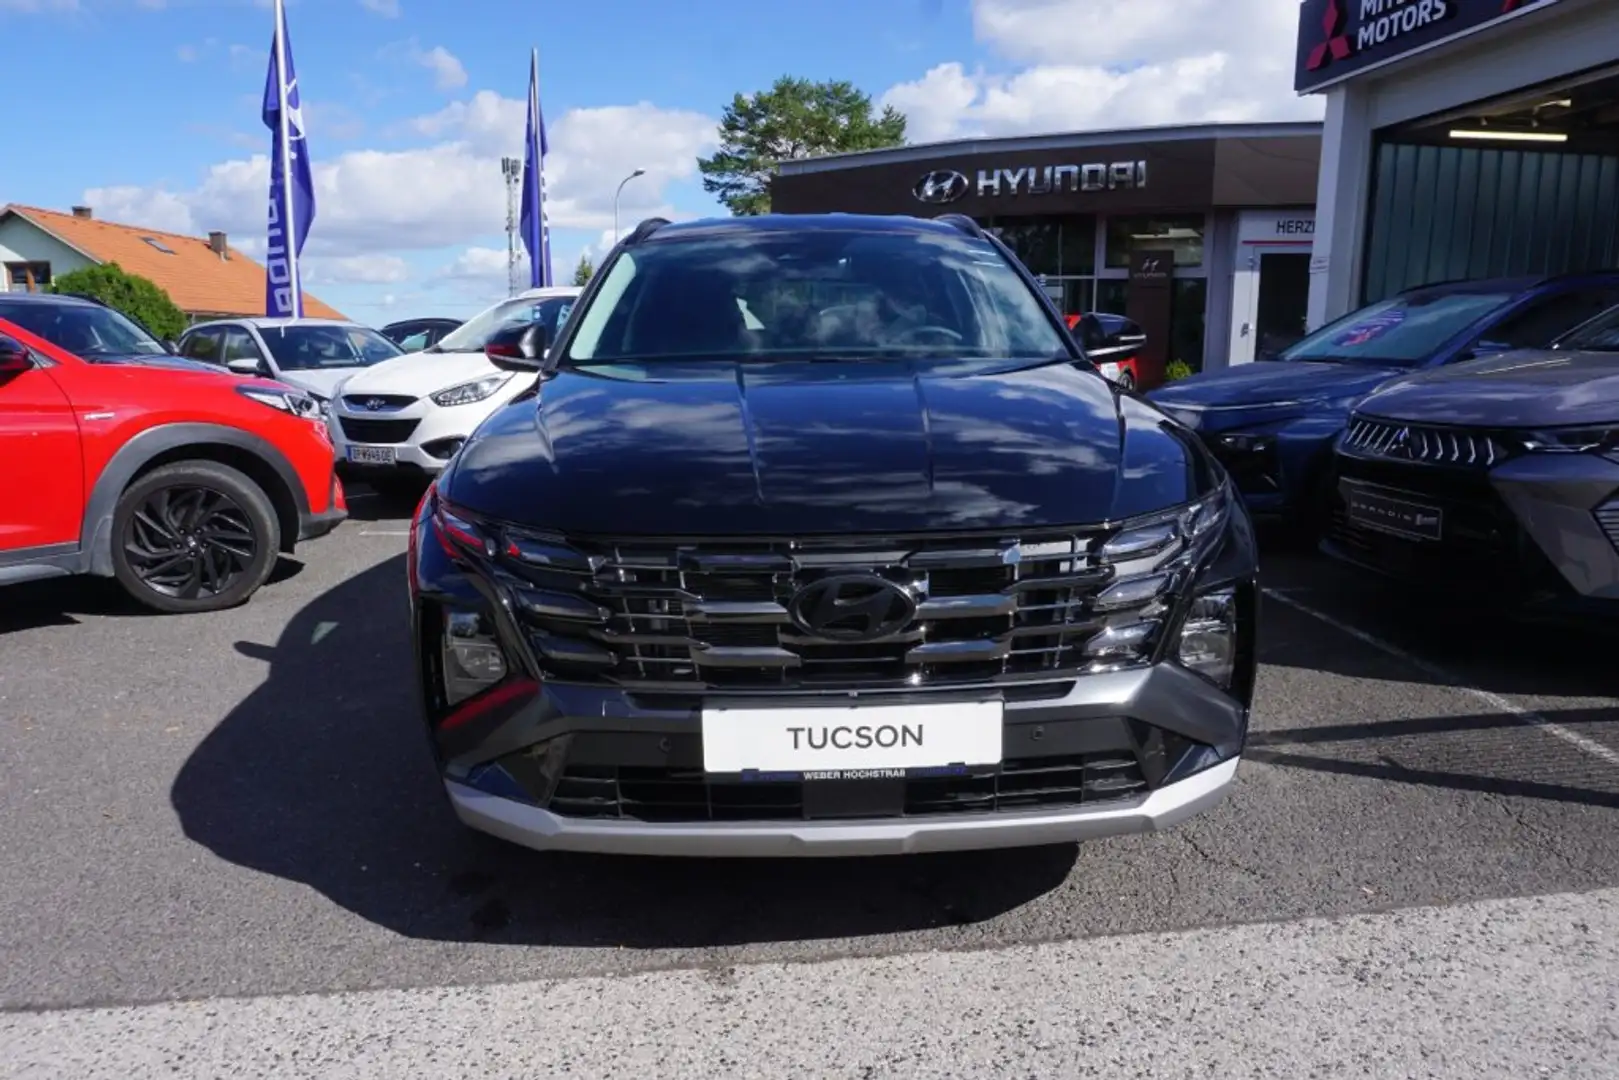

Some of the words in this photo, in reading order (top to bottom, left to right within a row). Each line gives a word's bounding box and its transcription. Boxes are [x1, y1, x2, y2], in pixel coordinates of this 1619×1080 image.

[1357, 0, 1447, 50] MOTORS
[977, 160, 1147, 197] HYUNDAI
[786, 724, 923, 750] TUCSON
[803, 770, 841, 780] WEBER
